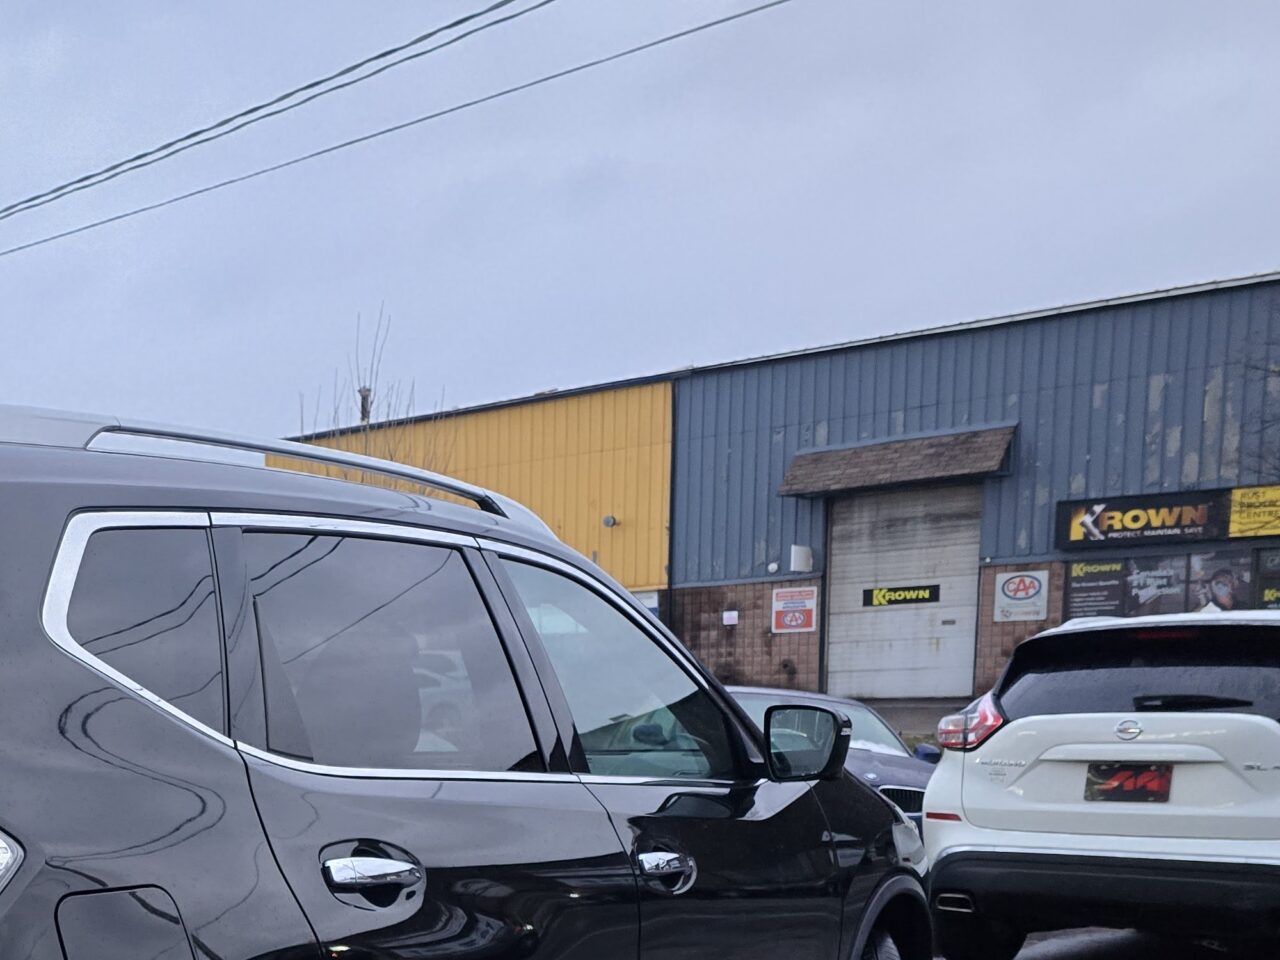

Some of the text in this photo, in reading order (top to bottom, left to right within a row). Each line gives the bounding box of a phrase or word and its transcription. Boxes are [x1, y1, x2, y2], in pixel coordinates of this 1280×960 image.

[1070, 503, 1209, 541] KROWN
[1071, 562, 1122, 577] KROWN
[1006, 577, 1037, 597] CAA
[872, 588, 930, 606] KROWN
